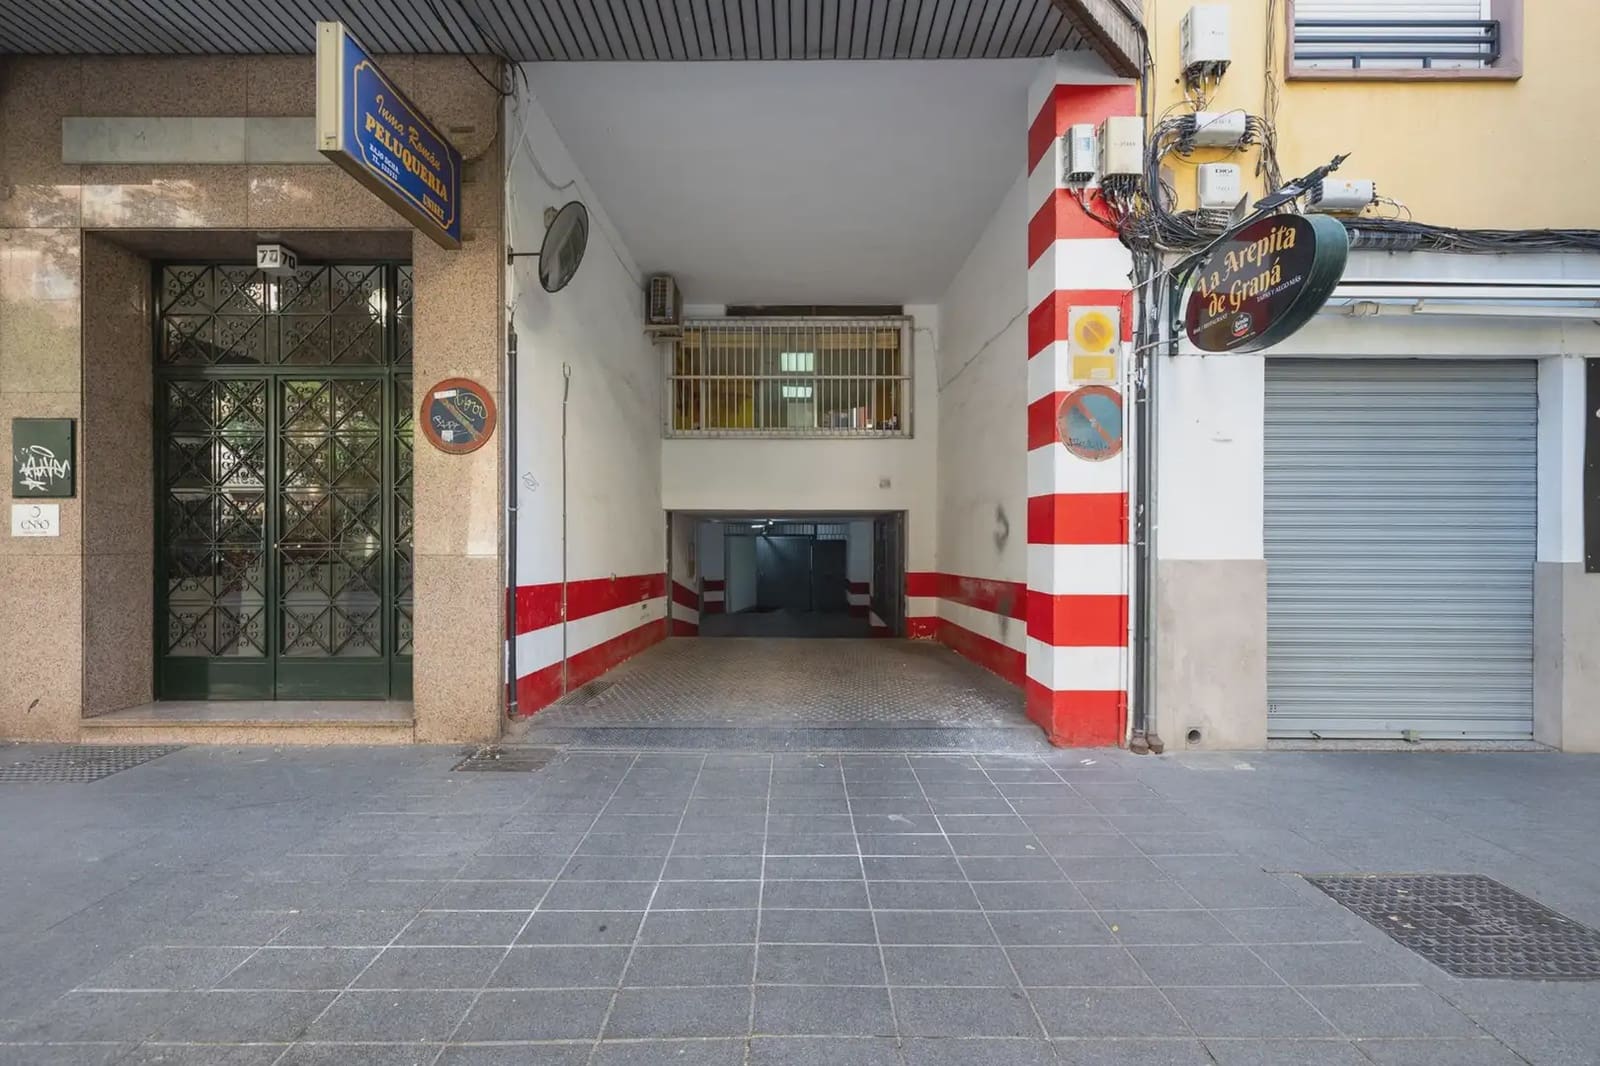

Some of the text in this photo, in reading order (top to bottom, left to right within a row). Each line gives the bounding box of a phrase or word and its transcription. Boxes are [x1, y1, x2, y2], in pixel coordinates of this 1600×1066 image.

[365, 111, 449, 202] PELUQUERIA
[1197, 225, 1297, 299] La Arepita
[1208, 256, 1282, 318] de Graná
